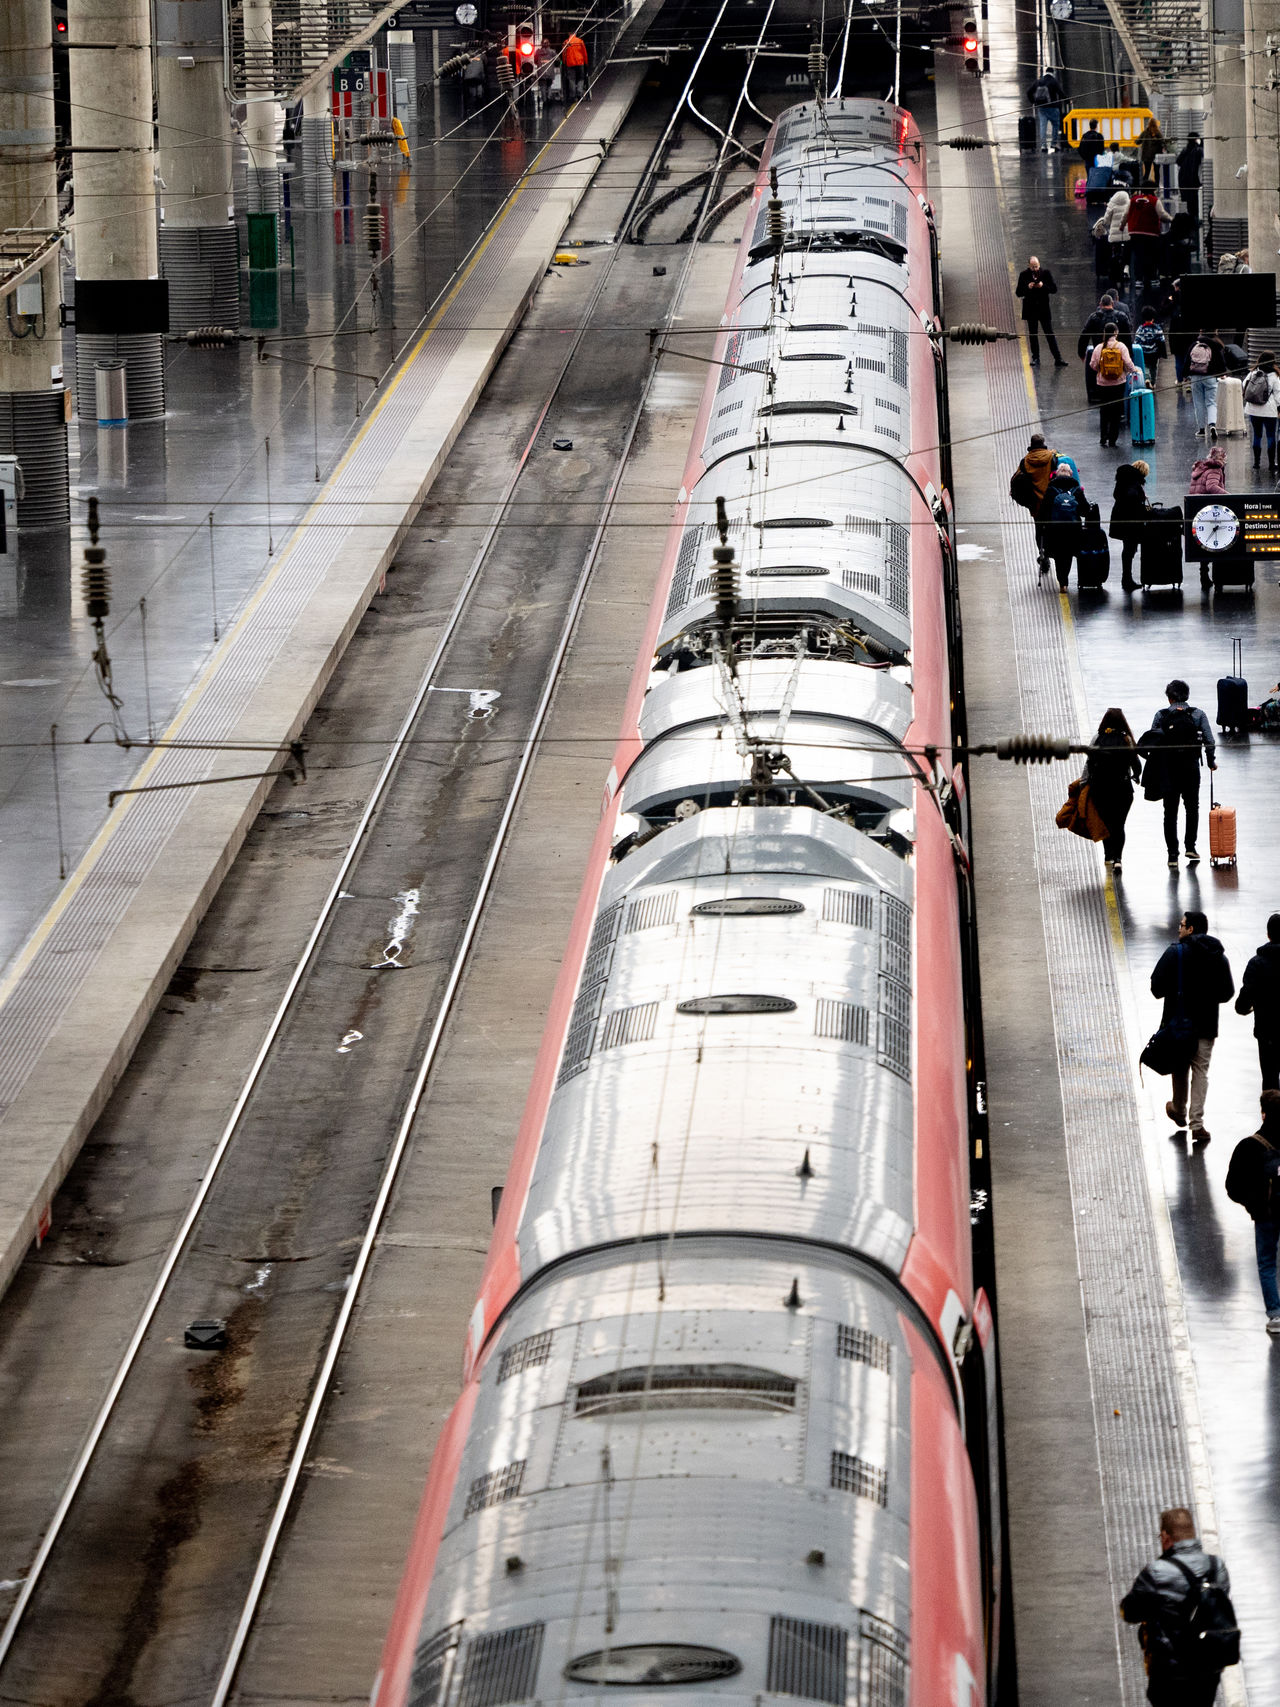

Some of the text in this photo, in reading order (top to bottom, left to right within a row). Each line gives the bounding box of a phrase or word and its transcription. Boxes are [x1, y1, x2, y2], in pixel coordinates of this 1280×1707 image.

[387, 15, 397, 27] 6
[340, 78, 364, 91] B 6
[1244, 522, 1268, 530] Destino
